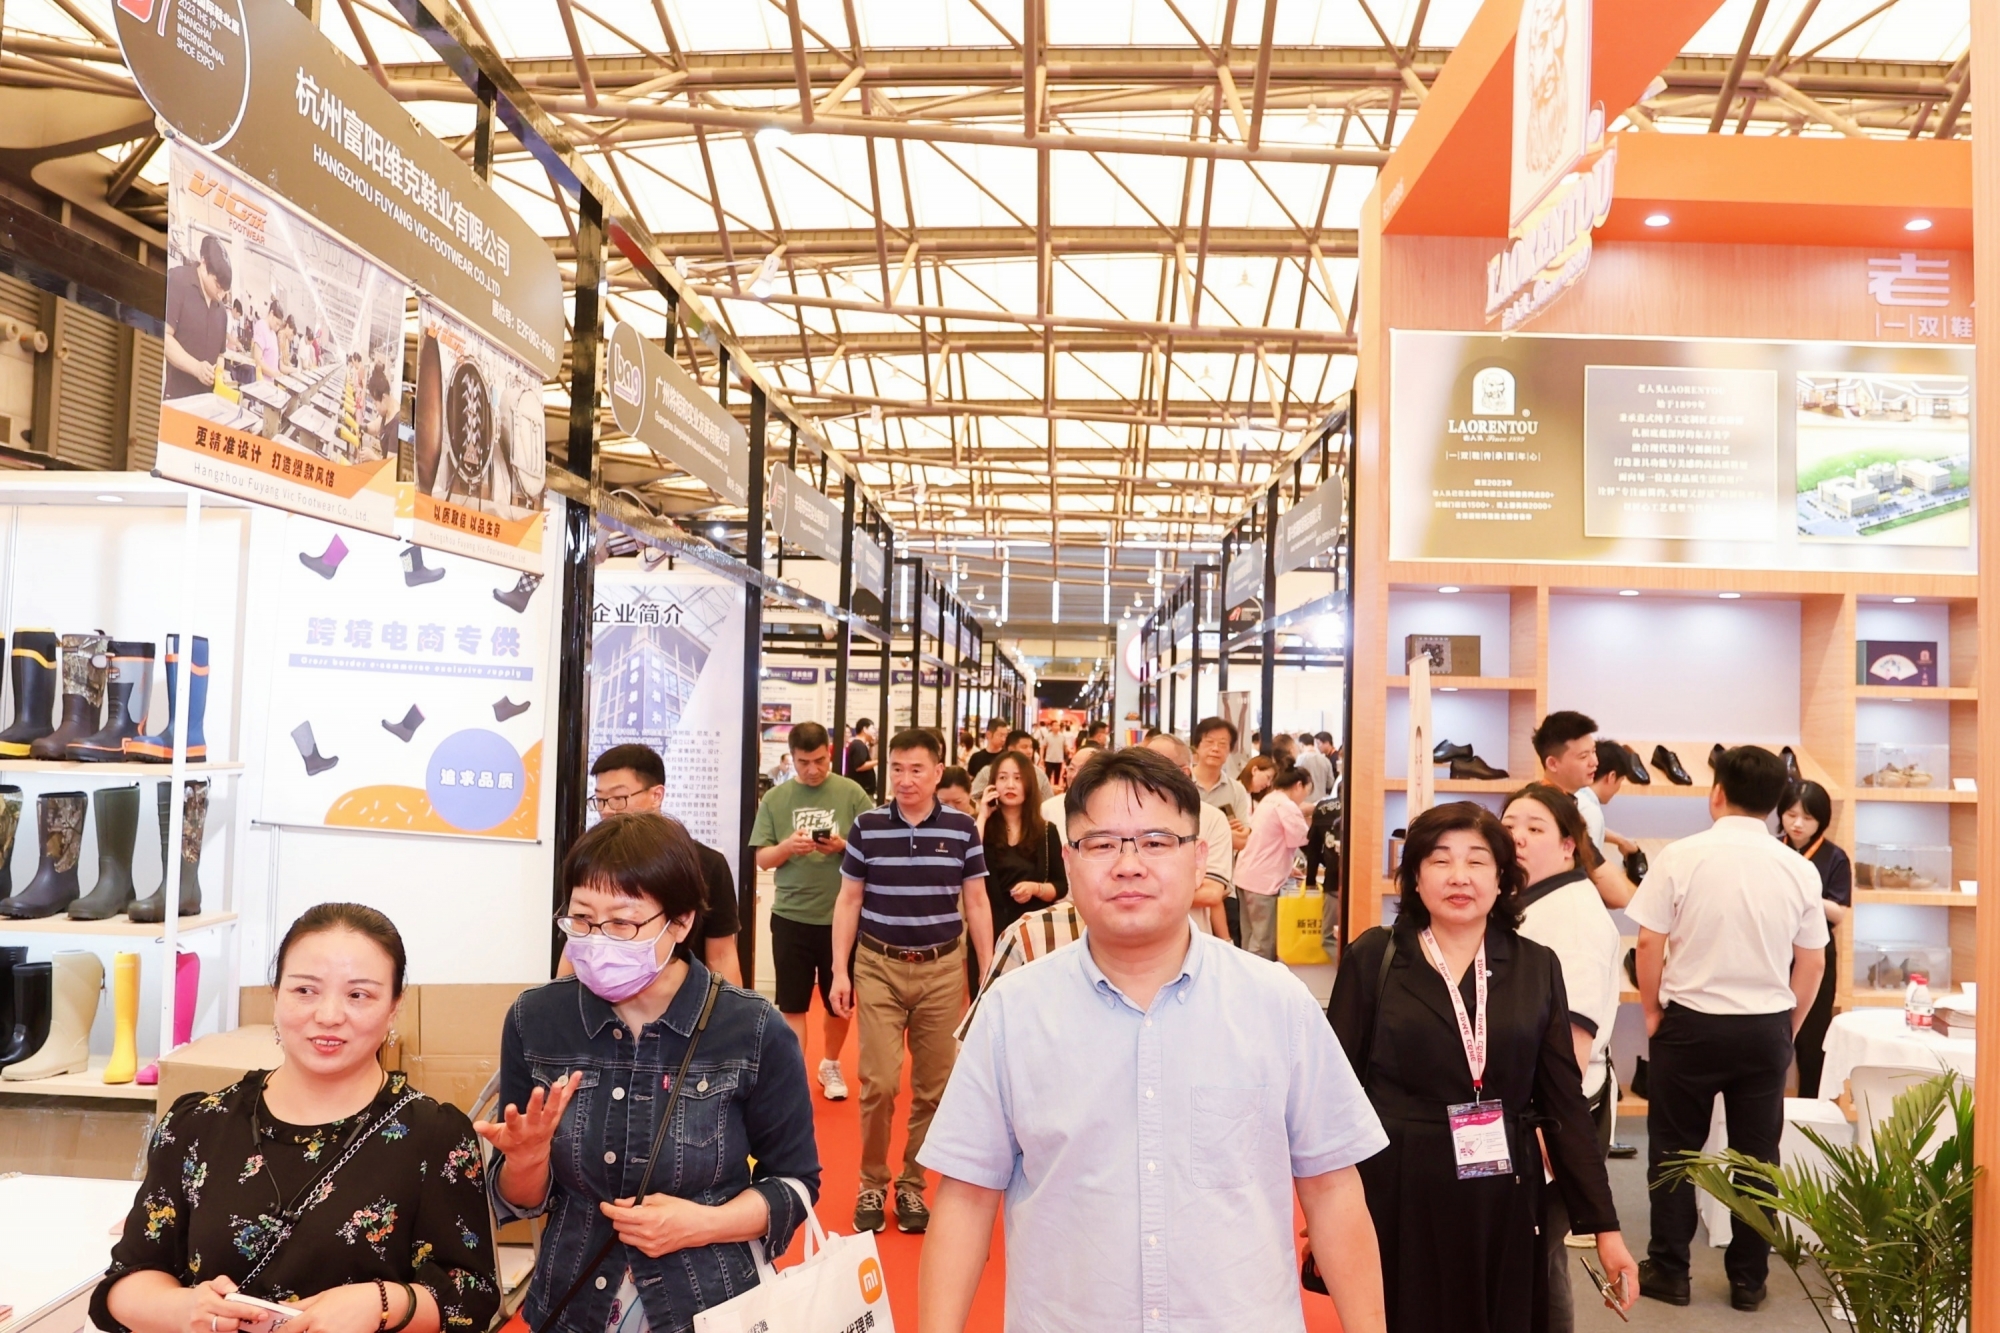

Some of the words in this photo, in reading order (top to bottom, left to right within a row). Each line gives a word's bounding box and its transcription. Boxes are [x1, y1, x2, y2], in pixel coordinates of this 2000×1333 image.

[177, 9, 212, 42] SHANGHAI
[196, 8, 209, 27] THE
[176, 36, 195, 59] SHOE
[196, 50, 215, 71] EXPO
[177, 22, 225, 66] INTERNATIONAL
[295, 66, 511, 278] 杭州富阳维克鞋业有限公司
[313, 143, 373, 207] HANGZHOU
[374, 187, 412, 232] FUYANG
[413, 215, 429, 243] VIC
[429, 225, 473, 279] FOOTWEAR
[228, 218, 266, 246] FOOTWEAR
[1656, 399, 1706, 410] 始于1899年
[1448, 420, 1538, 435] LAORENTOU
[195, 425, 262, 465] 更精准设计
[271, 451, 336, 488] 打造爆款风格
[193, 462, 245, 490] Hangzhou
[248, 476, 280, 503] Fuyang
[281, 483, 296, 501] Vic
[297, 489, 337, 515] Footwear
[434, 503, 467, 529] 以质取信
[469, 516, 502, 540] 以品生存
[593, 602, 684, 625] 企业简介
[306, 616, 521, 658] 跨境电商专供
[332, 658, 366, 669] border
[434, 664, 483, 676] exclusive
[487, 667, 522, 680] supply
[439, 768, 515, 790] 追求品质
